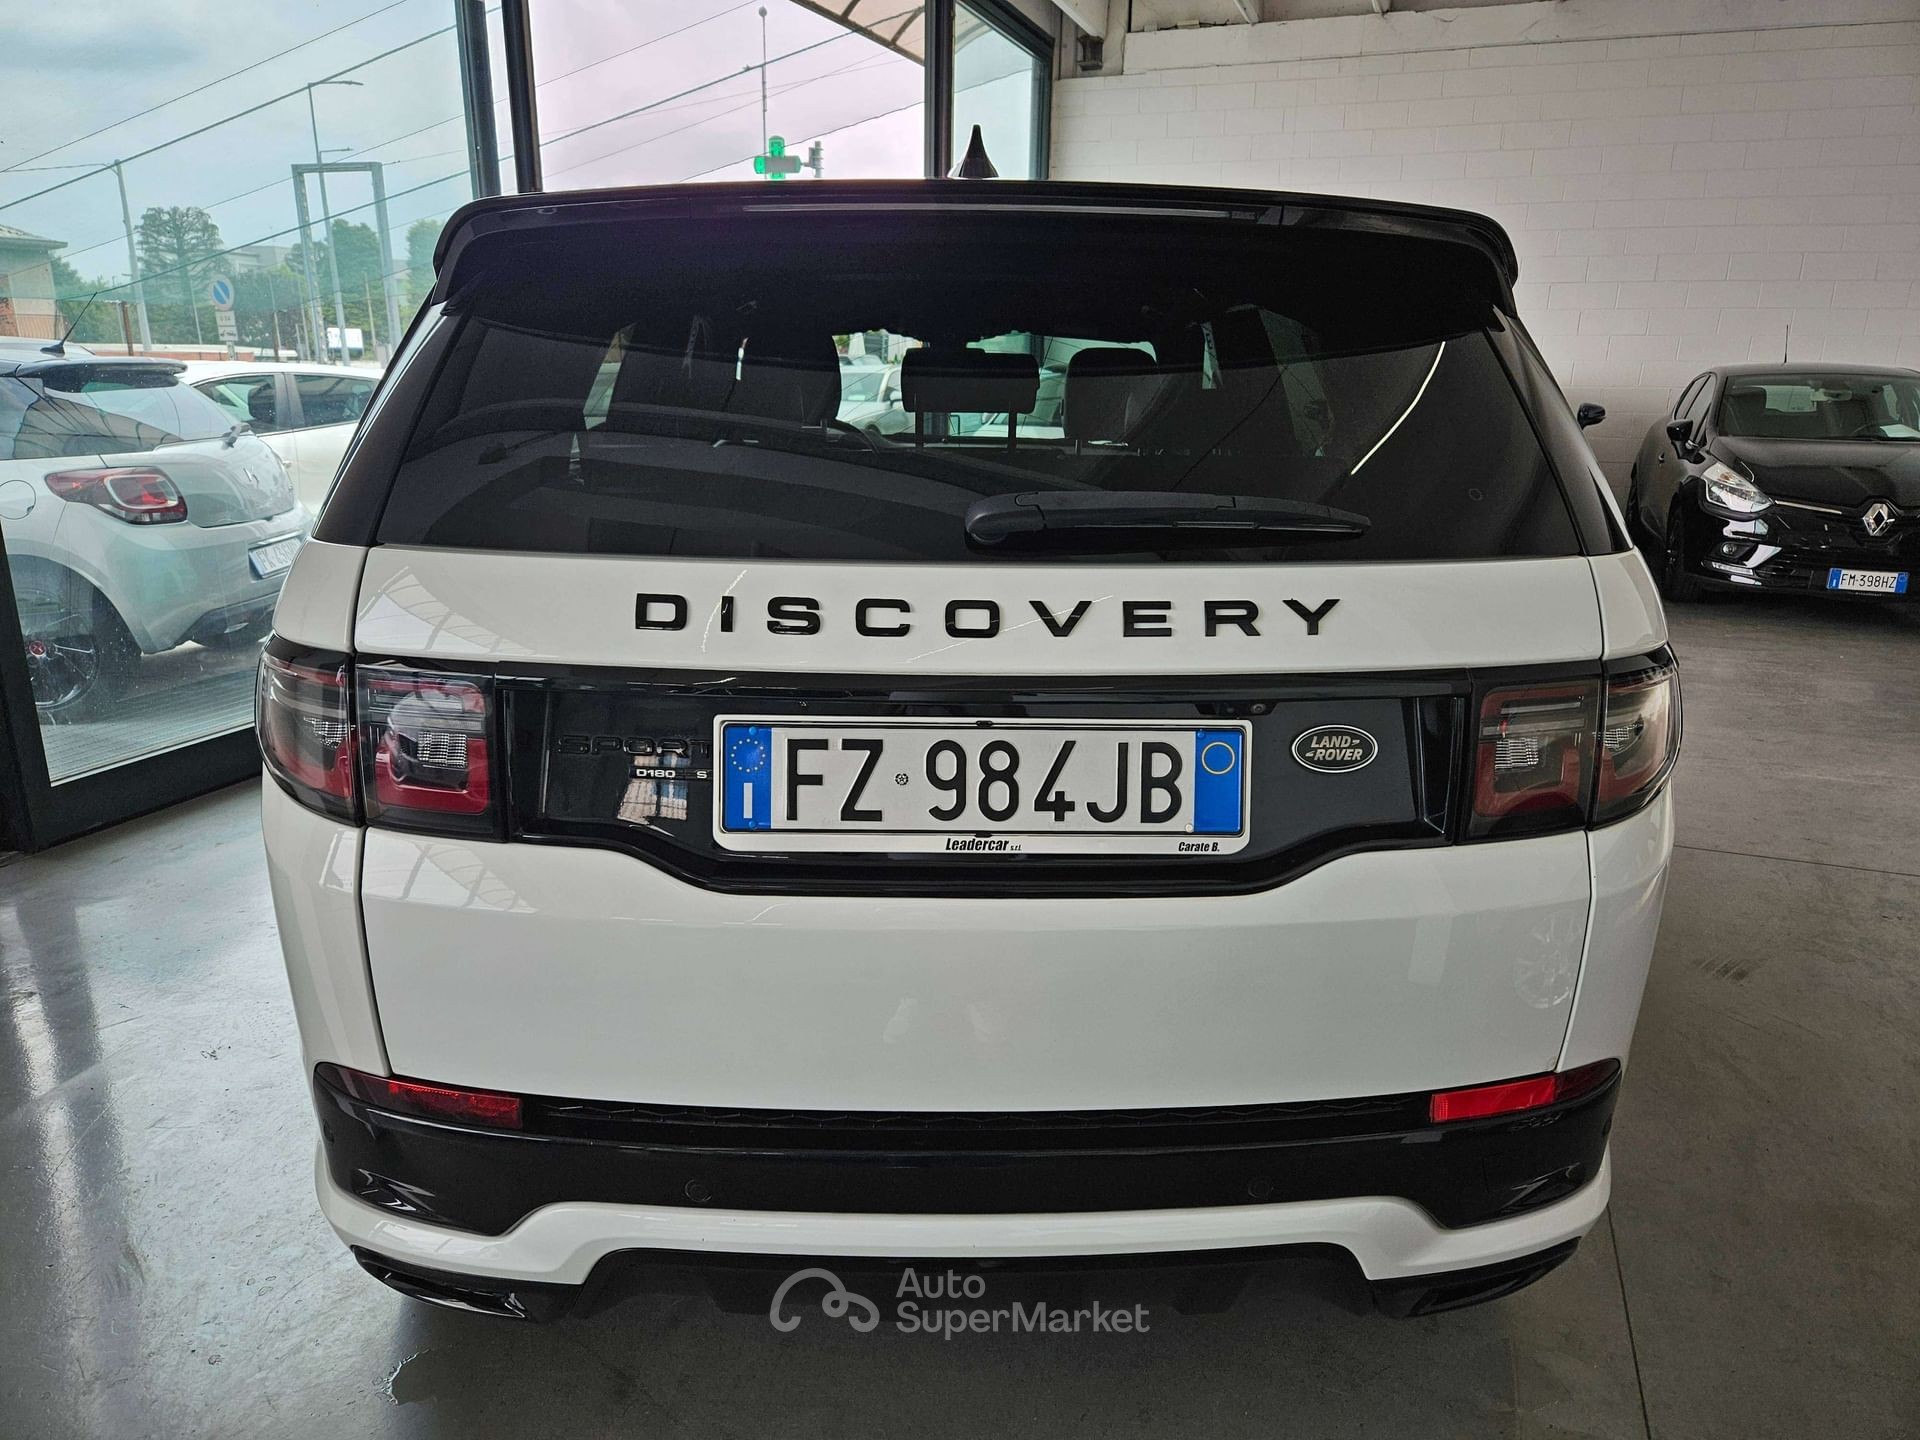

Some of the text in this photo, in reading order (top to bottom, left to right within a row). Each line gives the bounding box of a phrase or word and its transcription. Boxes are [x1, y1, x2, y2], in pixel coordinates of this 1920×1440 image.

[635, 593, 1340, 638] DISCOVERY
[558, 735, 714, 760] SPORT
[1310, 735, 1352, 748] LAND
[1313, 749, 1363, 761] ROVER
[636, 768, 676, 778] D180
[785, 738, 884, 823] FZ
[925, 739, 1183, 824] 984JB
[945, 837, 1009, 851] Leadercar
[1178, 841, 1220, 852] Carate B.
